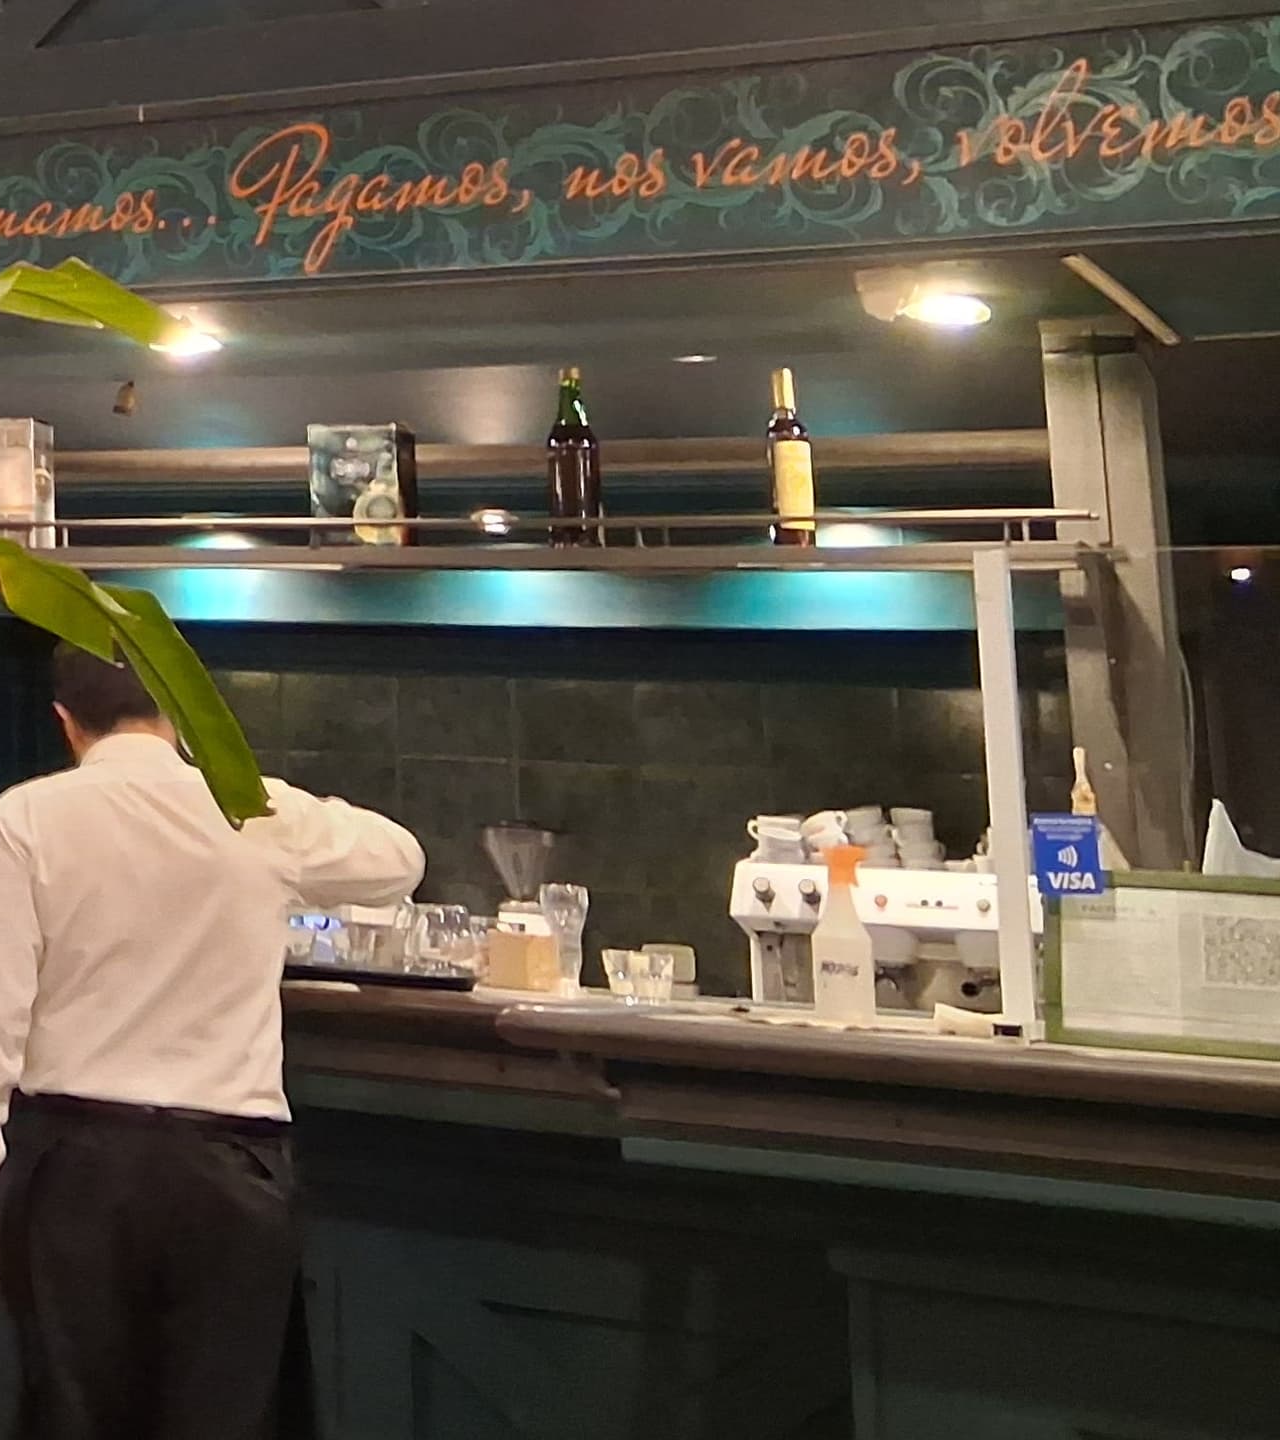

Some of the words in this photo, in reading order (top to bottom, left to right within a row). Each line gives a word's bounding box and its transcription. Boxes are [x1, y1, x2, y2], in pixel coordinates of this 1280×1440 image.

[228, 121, 532, 276] Pagamos,
[564, 146, 668, 200] nos
[691, 125, 922, 190] vamos,
[1046, 871, 1097, 890] VISA
